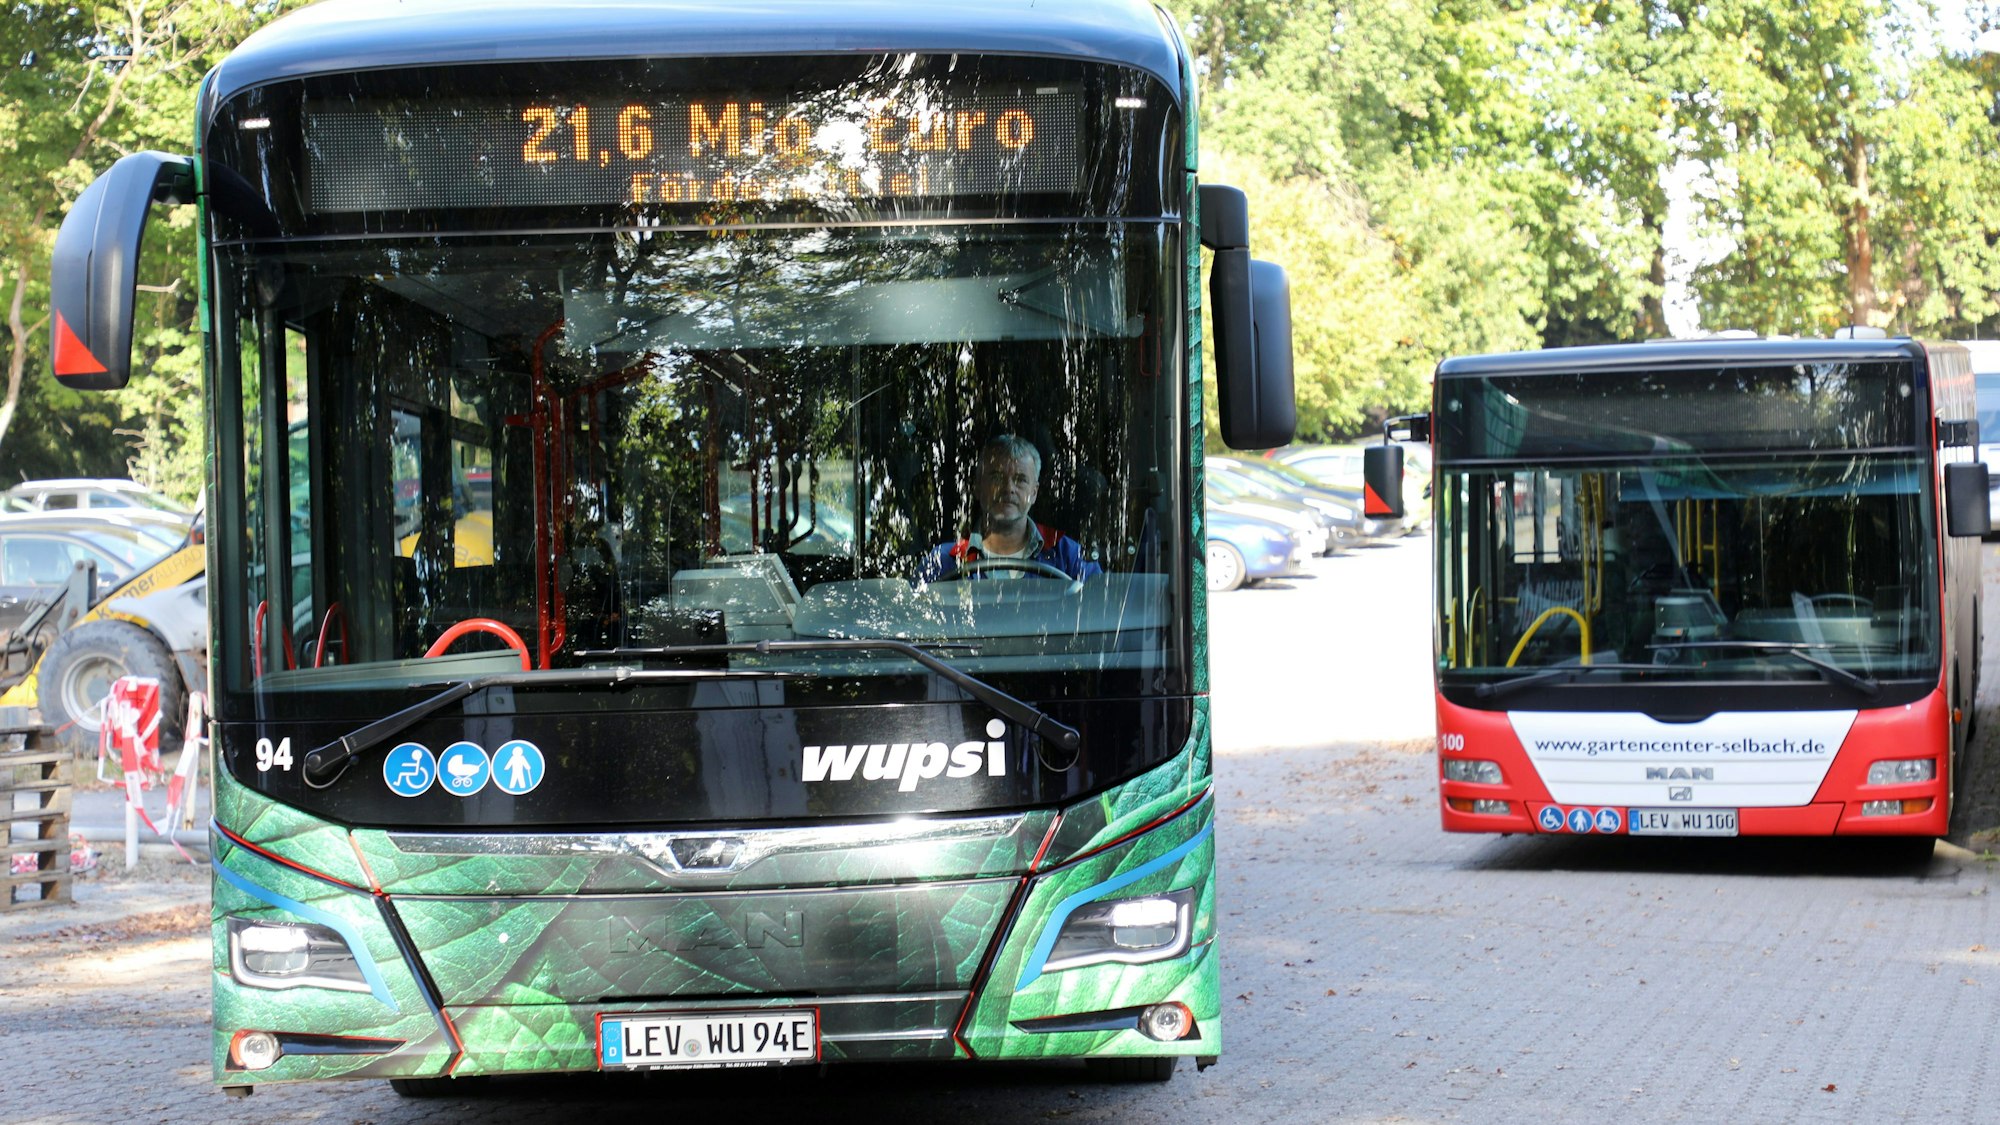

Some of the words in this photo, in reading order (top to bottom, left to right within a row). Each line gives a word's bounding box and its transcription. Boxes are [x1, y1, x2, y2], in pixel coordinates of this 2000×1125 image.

[523, 105, 652, 168] 21,6
[255, 737, 293, 771] 94
[802, 718, 1006, 792] wupsi
[1442, 733, 1465, 751] 100
[1535, 739, 1825, 755] www.gartencenter-selbach.de
[1646, 767, 1714, 780] MAN
[1640, 813, 1669, 829] LEV
[1682, 814, 1701, 829] WU
[1706, 814, 1734, 829] 100
[610, 911, 804, 953] MAN
[609, 1047, 617, 1056] D
[625, 1025, 681, 1056] LEV
[707, 1023, 744, 1054] WU
[754, 1021, 809, 1052] 94E
